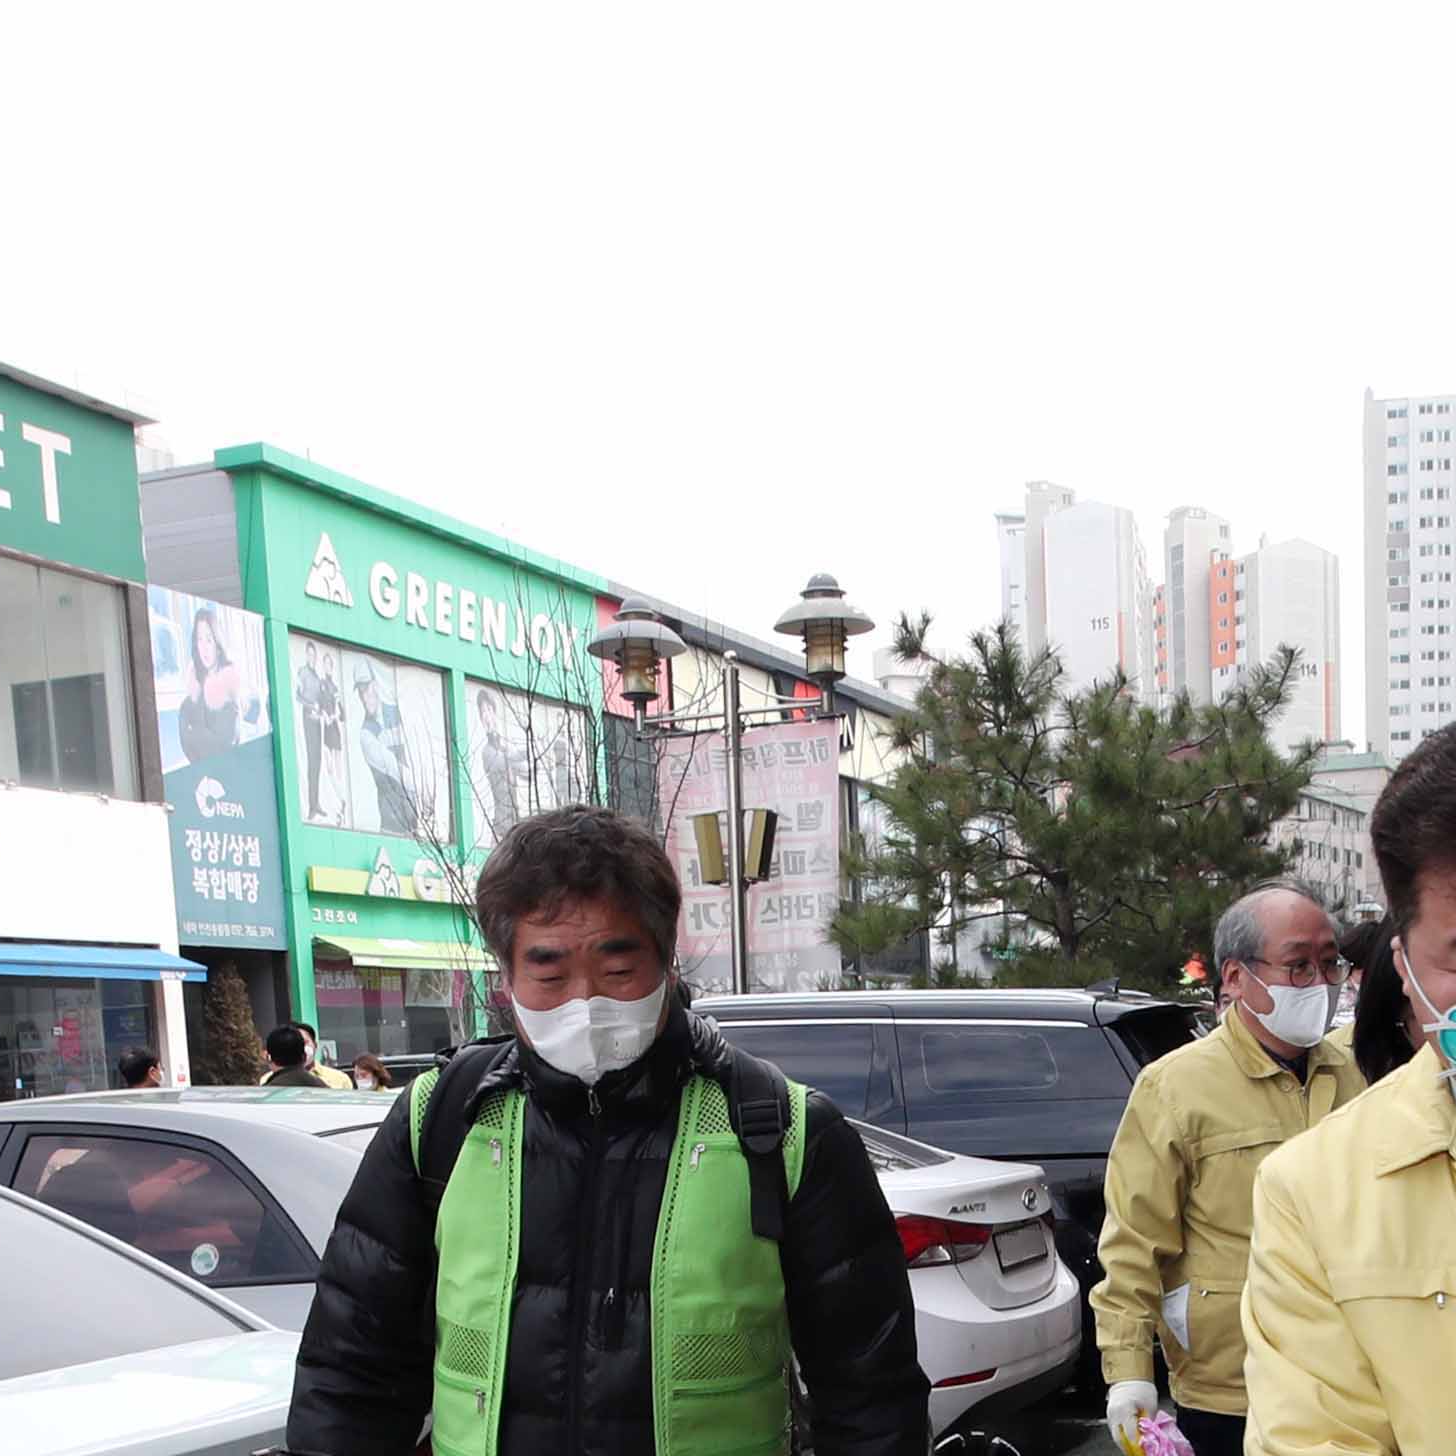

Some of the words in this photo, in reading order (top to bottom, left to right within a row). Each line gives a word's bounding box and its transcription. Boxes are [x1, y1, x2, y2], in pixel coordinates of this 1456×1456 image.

[368, 560, 578, 673] GREENJOY
[1090, 617, 1110, 631] 115
[216, 800, 245, 819] NEPA
[184, 828, 262, 868] 정상/상설
[191, 866, 260, 904] 복합매장
